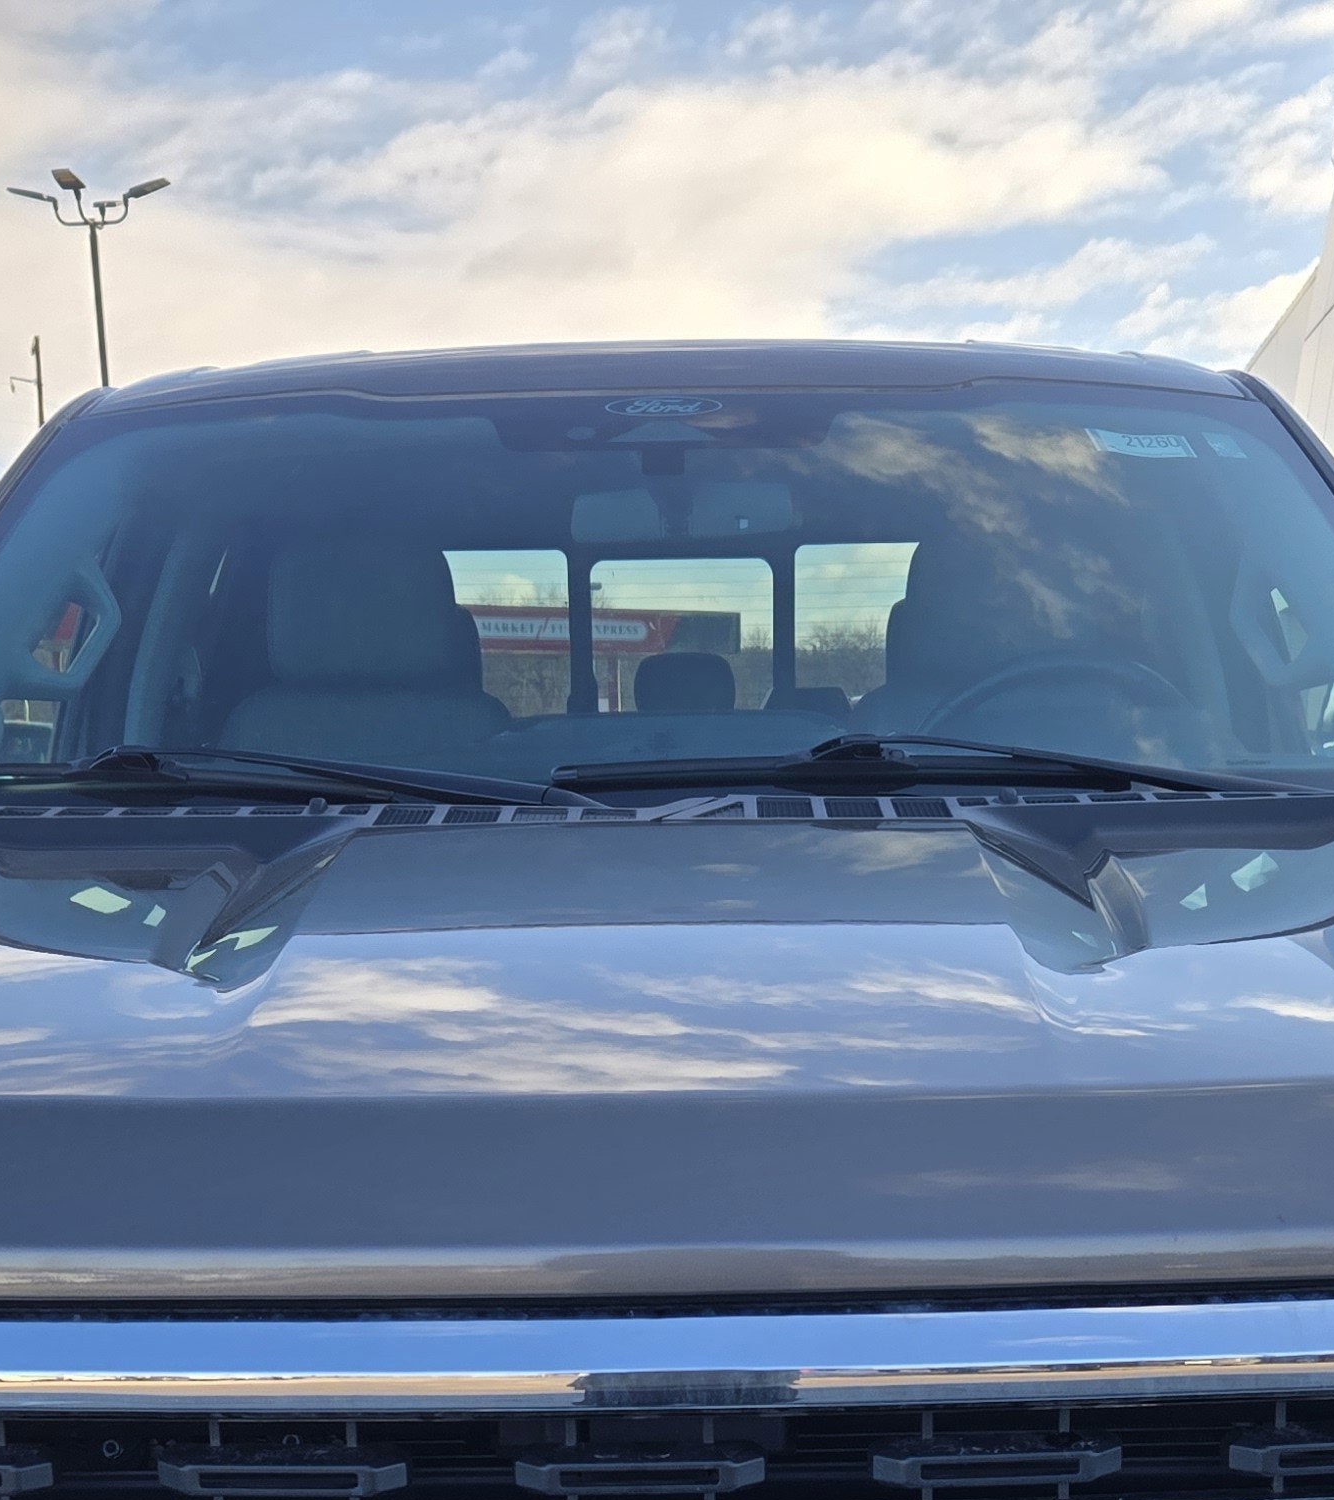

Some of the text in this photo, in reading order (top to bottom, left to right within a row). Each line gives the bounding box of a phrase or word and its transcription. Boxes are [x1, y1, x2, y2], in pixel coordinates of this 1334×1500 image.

[625, 398, 703, 413] Ford
[480, 622, 535, 634] MARKET
[594, 625, 640, 636] XPRESS
